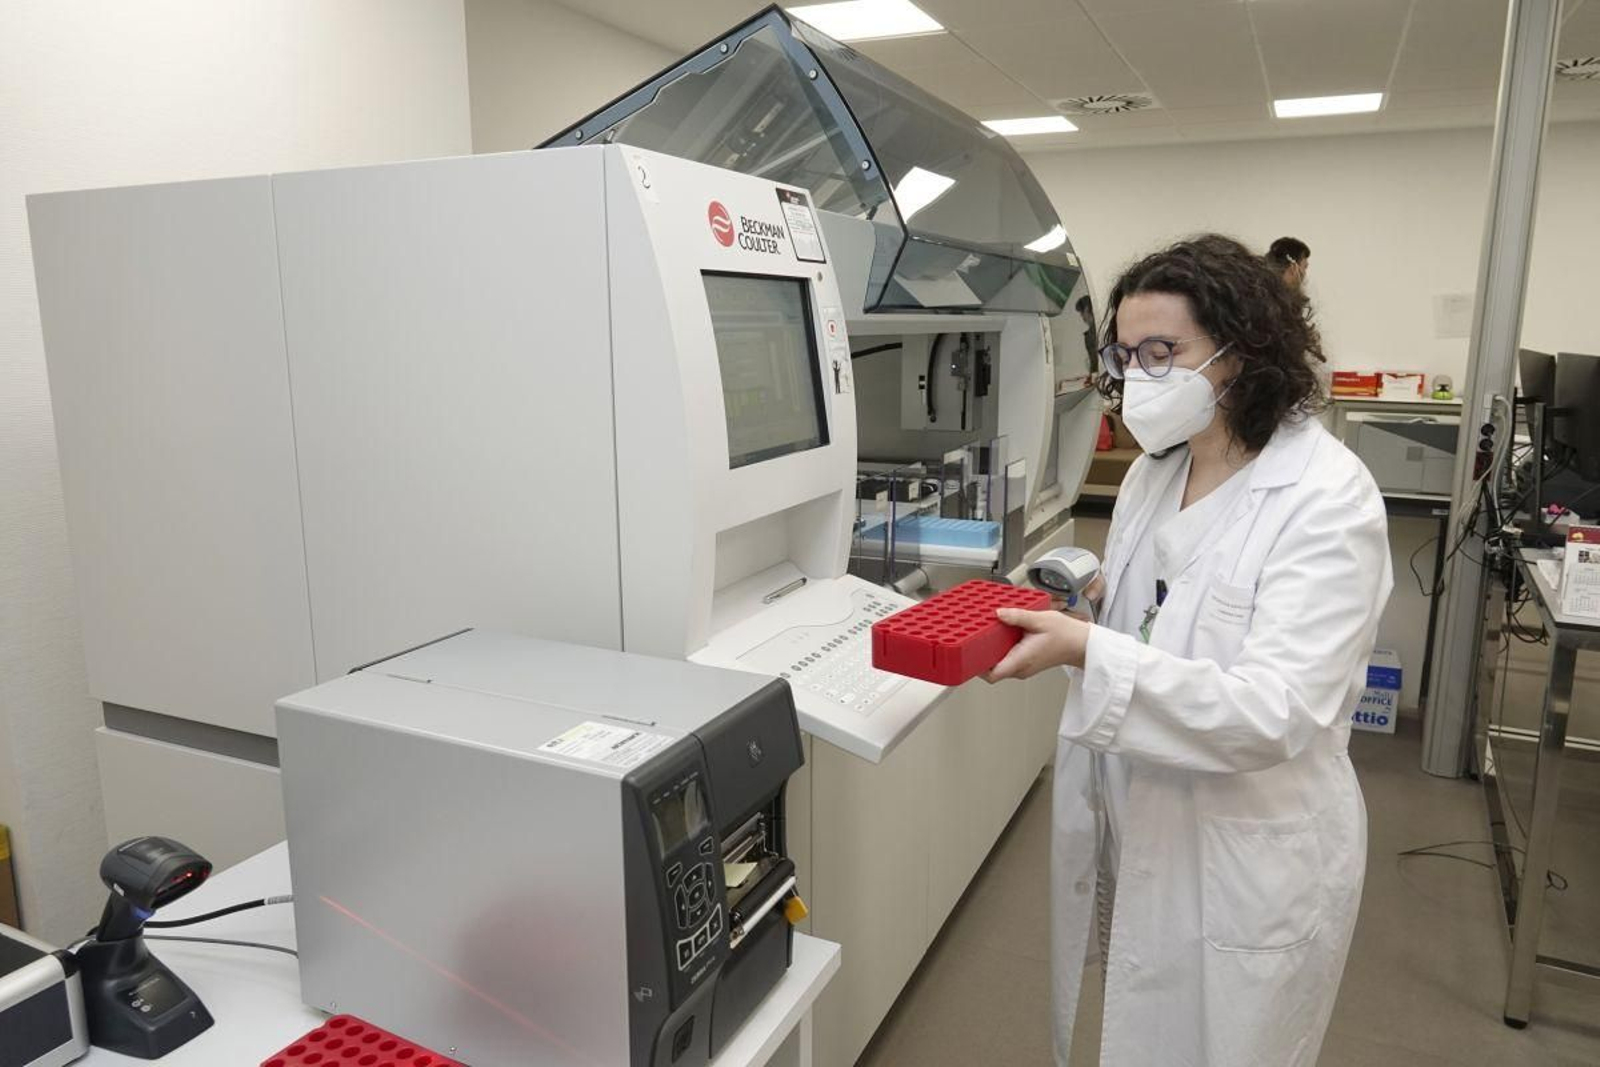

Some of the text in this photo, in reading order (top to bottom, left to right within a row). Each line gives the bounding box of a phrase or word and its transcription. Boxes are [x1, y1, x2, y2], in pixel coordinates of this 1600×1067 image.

[740, 216, 785, 239] BECKMAN
[738, 232, 781, 255] COULTER
[1352, 711, 1388, 726] ttio
